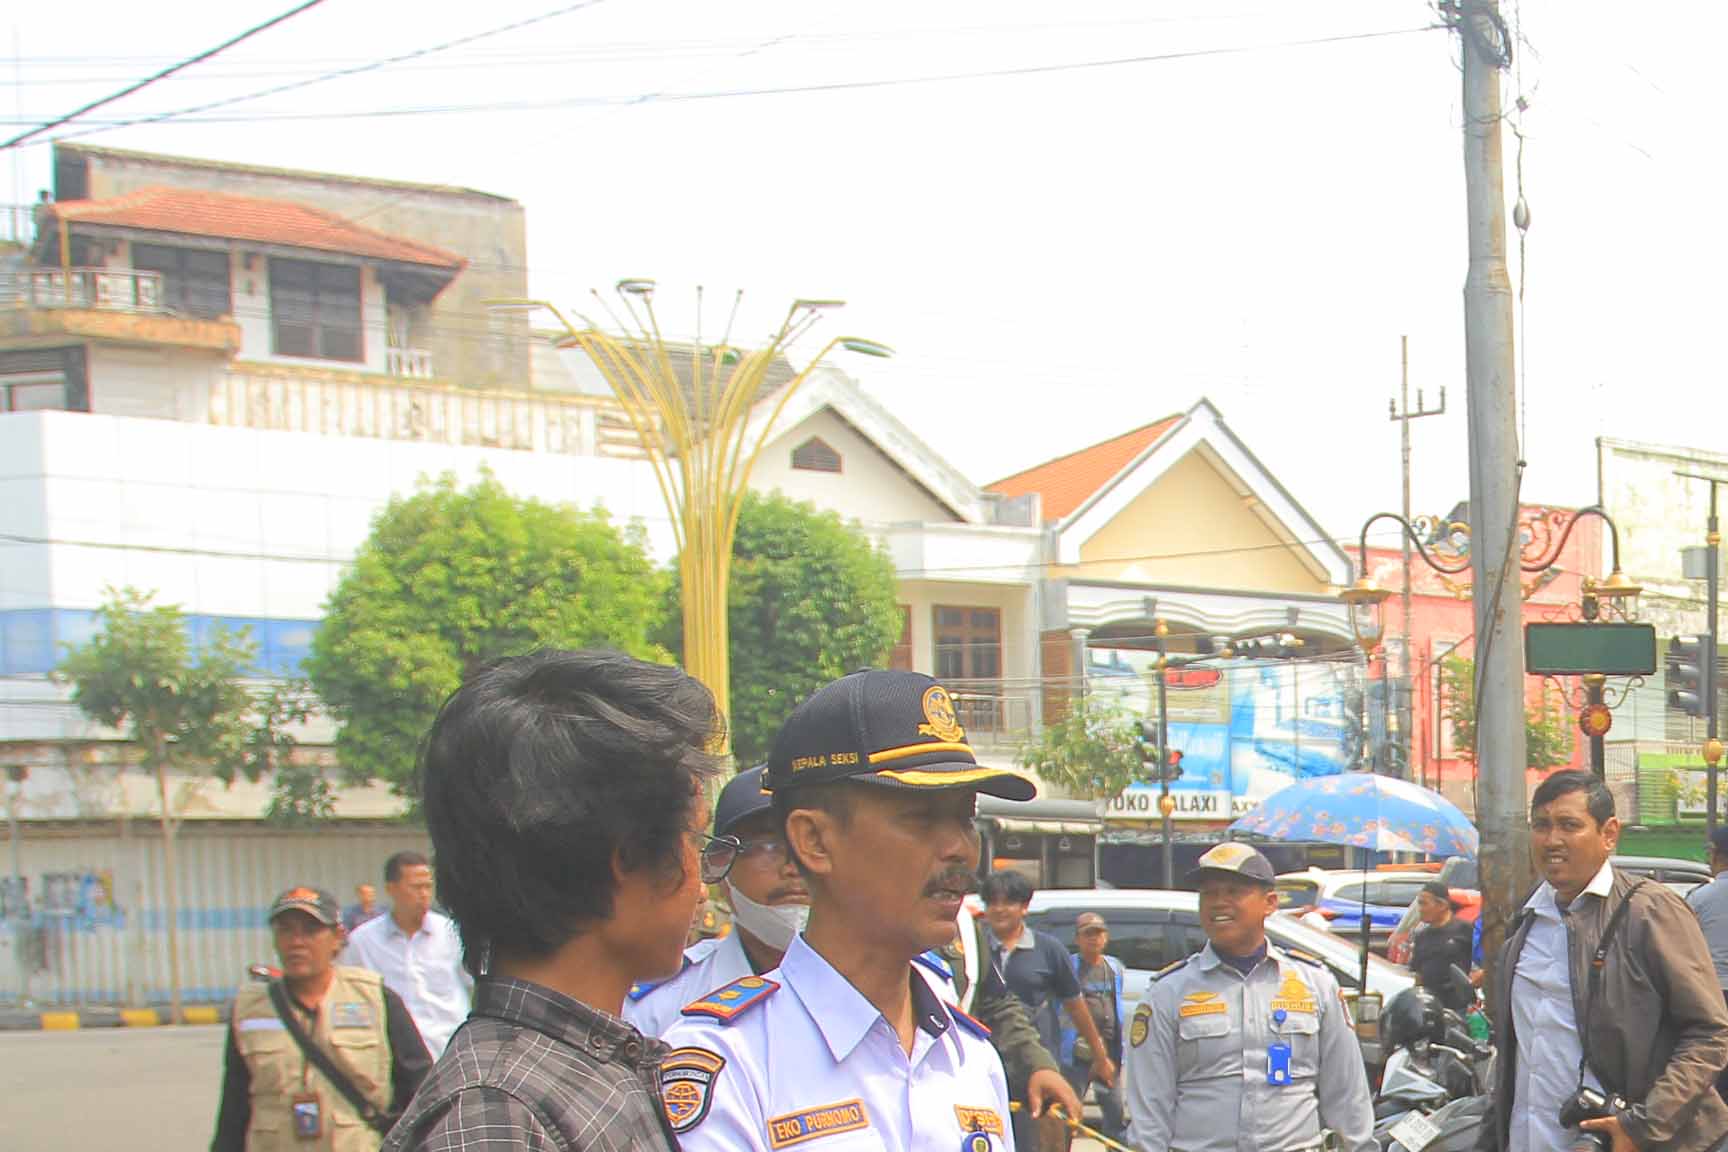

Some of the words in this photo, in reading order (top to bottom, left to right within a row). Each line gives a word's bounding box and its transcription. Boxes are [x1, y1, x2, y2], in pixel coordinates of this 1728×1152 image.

[792, 755, 826, 771] KEPALA
[831, 752, 859, 765] SEKSI
[776, 1119, 801, 1139] EKO
